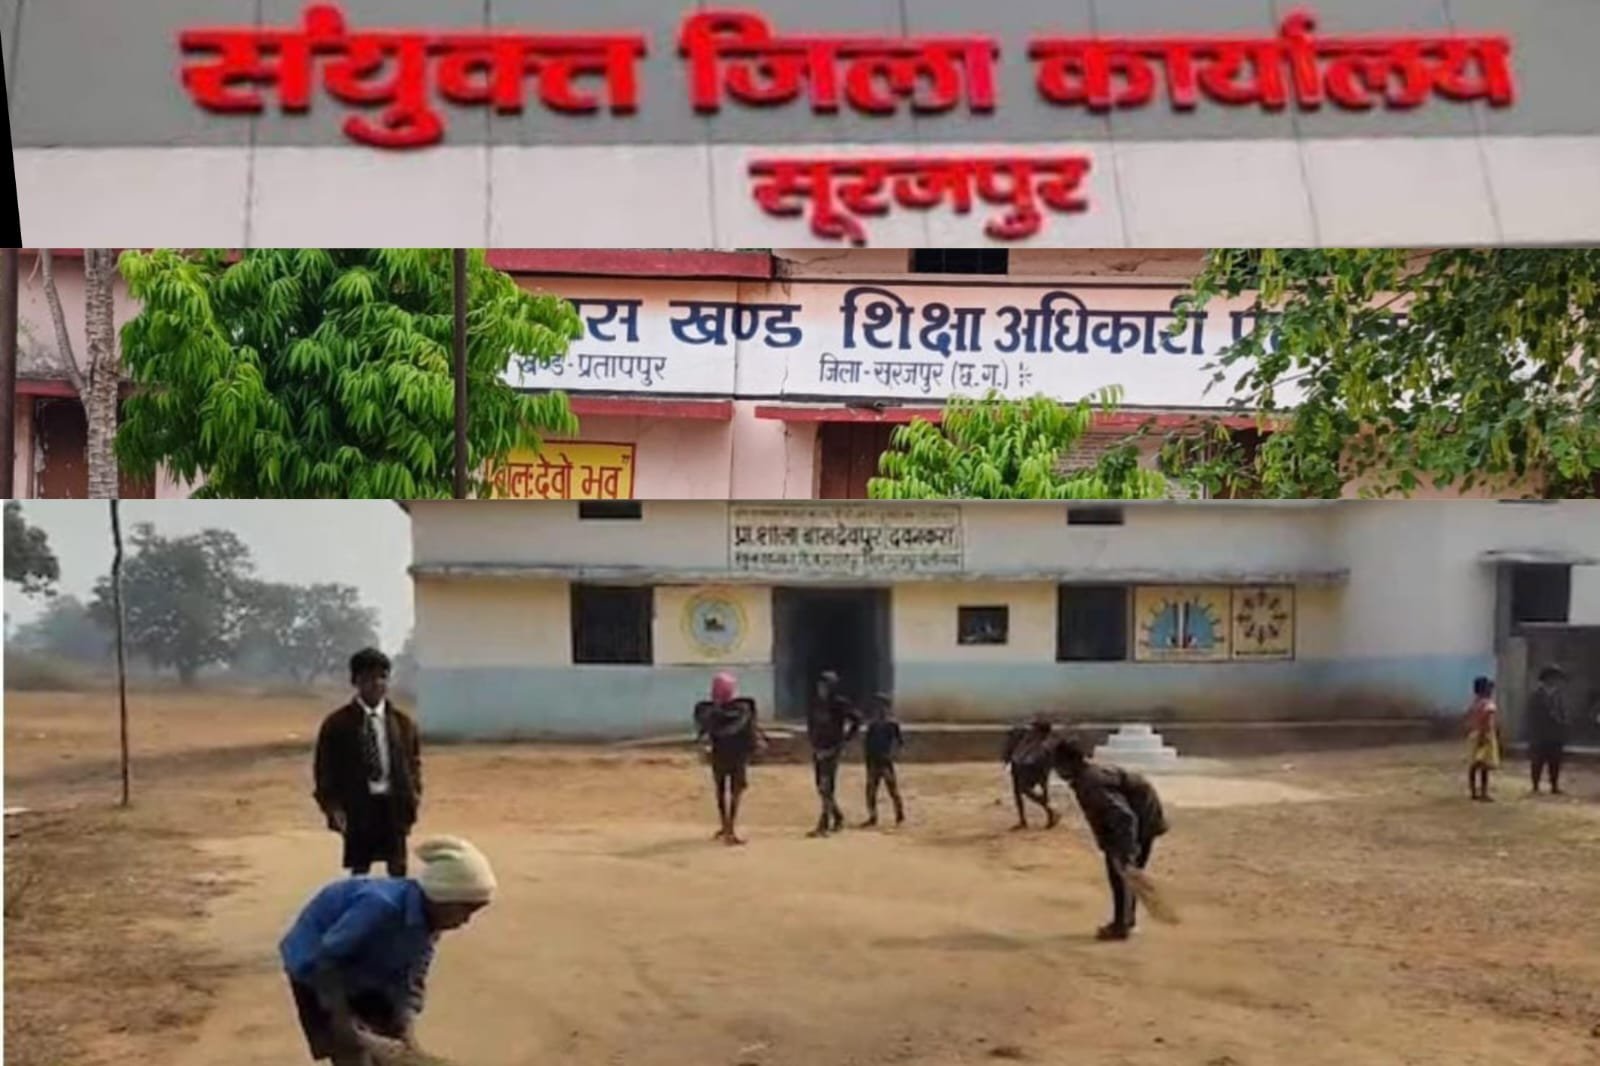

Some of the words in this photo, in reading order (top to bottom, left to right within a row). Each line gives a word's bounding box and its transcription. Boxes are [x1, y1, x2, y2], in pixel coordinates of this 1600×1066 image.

[179, 3, 648, 148] संयुक्त
[678, 8, 1000, 114] जिला
[1028, 10, 1515, 110] कार्यालय
[748, 155, 1092, 246] सूरजपुर
[669, 300, 803, 348] खण्ड
[839, 286, 987, 357] शिक्षा
[994, 291, 1208, 355] अधिकारी
